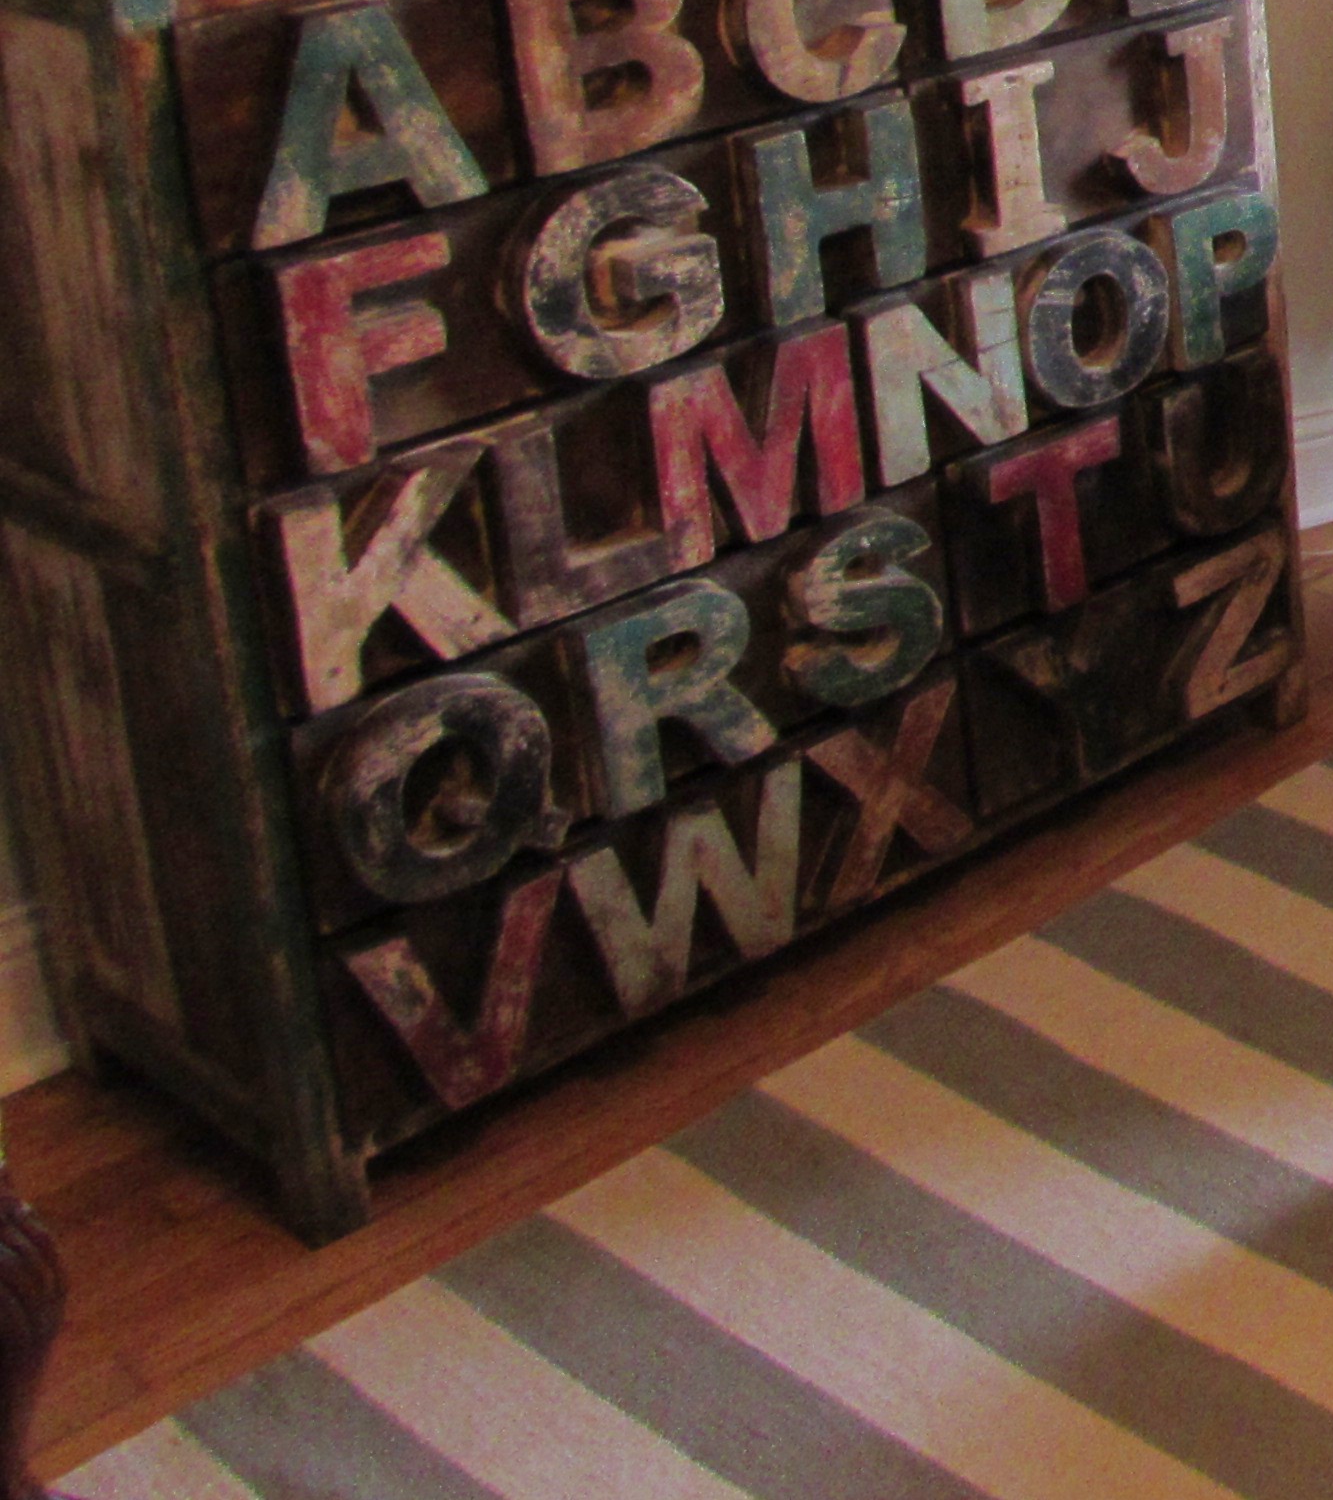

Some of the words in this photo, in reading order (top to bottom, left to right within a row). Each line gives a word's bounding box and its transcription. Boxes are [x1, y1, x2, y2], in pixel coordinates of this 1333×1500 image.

[251, 0, 491, 250] A
[277, 232, 452, 474] F
[523, 167, 726, 378] G
[754, 100, 927, 327] H
[960, 60, 1067, 257] I
[1108, 17, 1233, 195] J
[279, 443, 520, 716] K
[493, 422, 670, 632] L
[648, 322, 866, 578] M
[866, 269, 1030, 487] N
[1028, 229, 1169, 408] O
[1171, 192, 1279, 366] P
[328, 673, 570, 903] Q
[584, 584, 780, 816] R
[786, 518, 944, 705] S
[988, 414, 1122, 614] T
[343, 872, 564, 1113] V
[566, 760, 803, 1017] W
[805, 678, 976, 902] X
[1172, 531, 1292, 721] Z
